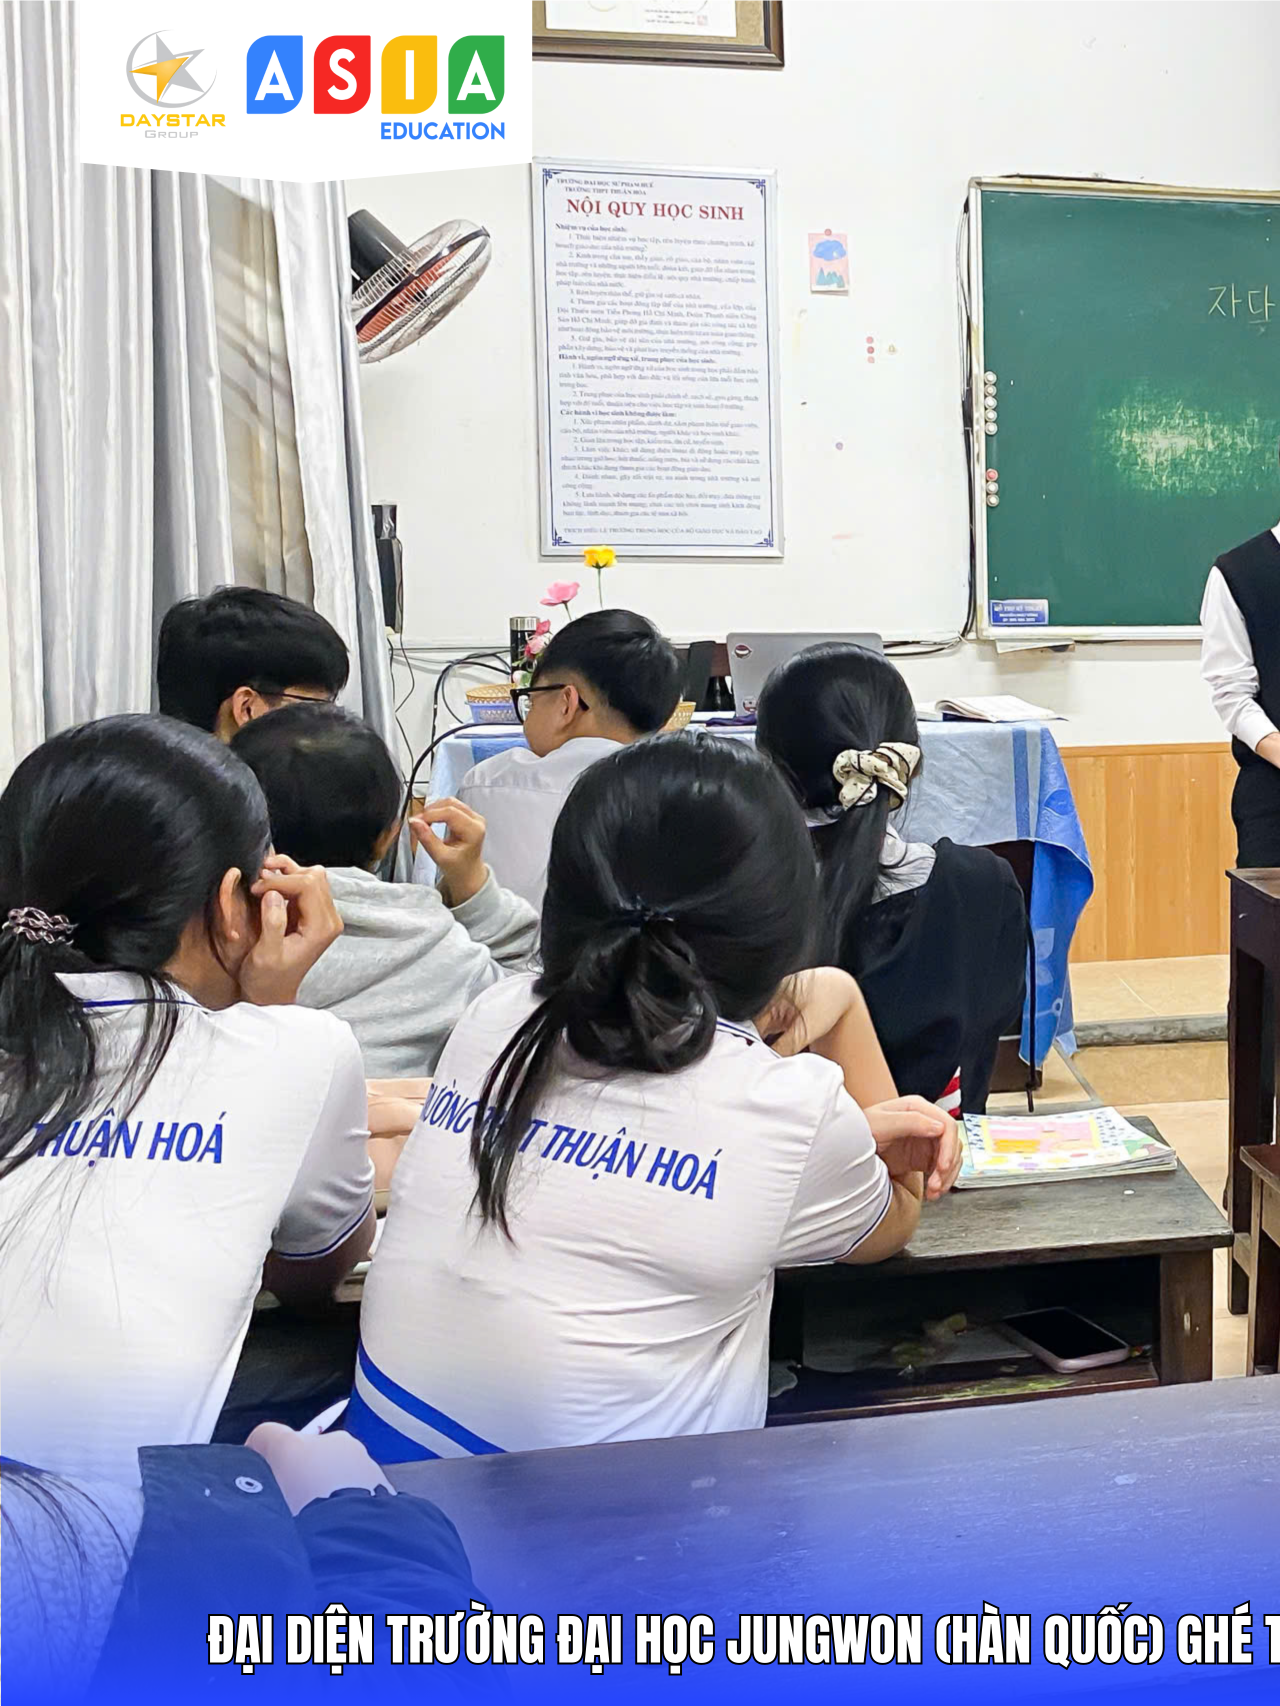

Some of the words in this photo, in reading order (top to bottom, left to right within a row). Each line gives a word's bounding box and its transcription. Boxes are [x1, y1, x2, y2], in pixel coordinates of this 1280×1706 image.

[566, 196, 601, 218] NỘI
[607, 200, 647, 219] QUY
[653, 202, 694, 222] HỌC
[699, 204, 745, 221] SINH
[1208, 282, 1276, 320] 자다
[147, 1111, 227, 1164] HOÁ
[421, 1079, 482, 1134] ƯỜNG
[541, 1123, 647, 1180] THUẬN
[645, 1144, 723, 1200] HOÁ
